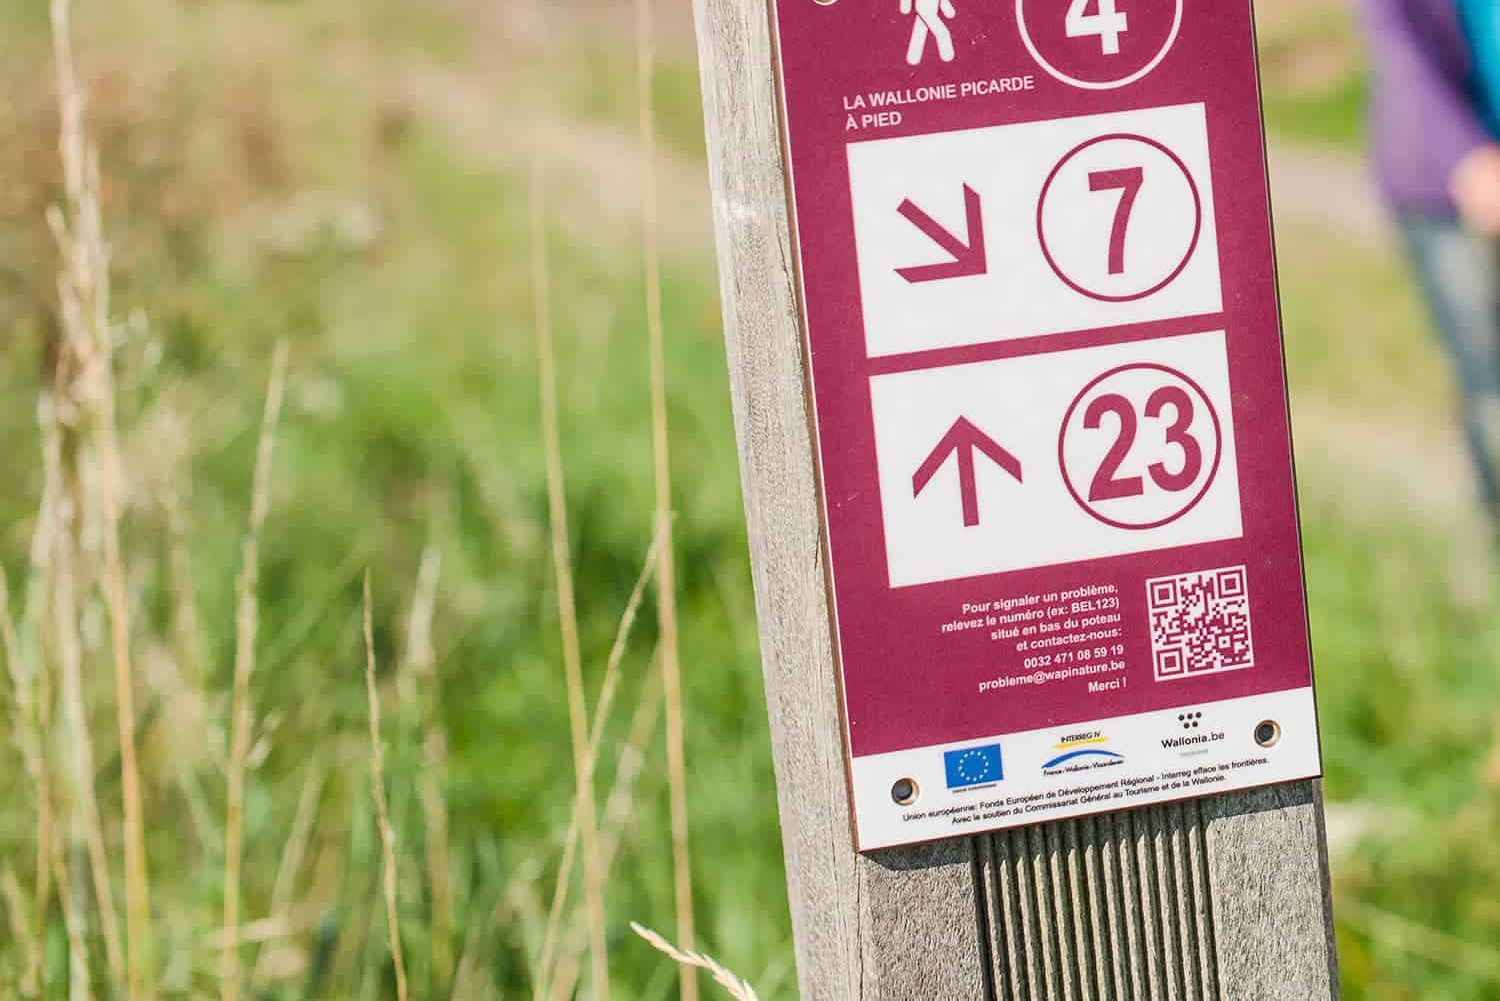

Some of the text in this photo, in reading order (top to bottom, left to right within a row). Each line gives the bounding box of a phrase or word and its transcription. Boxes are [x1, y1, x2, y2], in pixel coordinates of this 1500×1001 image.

[843, 75, 1035, 110] LA WALLONIE PICARDE
[845, 111, 902, 131] À PIED
[1088, 166, 1144, 275] 7
[1083, 385, 1202, 502] 23
[942, 597, 1120, 633] relevez le numéro (ex: BEL123)
[962, 602, 991, 614] Pour
[994, 596, 1040, 612] signaler
[1045, 593, 1058, 603] un
[991, 613, 1121, 640] situé en bas du poteau
[1016, 628, 1122, 652] et contactez-nous:
[1024, 644, 1124, 669] 0032 471 08 59 19
[978, 660, 1125, 693] probleme@wapinature.be
[1088, 679, 1120, 693] Merci
[1161, 732, 1225, 749] Wallonia.be
[902, 812, 926, 822] Union
[979, 799, 1005, 810] Fonds
[1006, 793, 1044, 808] Européen
[1046, 790, 1056, 799] de
[1121, 775, 1154, 789] Régional
[1162, 769, 1191, 782] Interreg
[1218, 762, 1230, 772] les
[952, 815, 972, 825] Avec
[974, 812, 981, 820] le
[983, 808, 1011, 820] soutien
[1013, 806, 1023, 815] du
[1025, 798, 1078, 813] Commissariat
[1080, 790, 1111, 803] Général
[1125, 785, 1160, 797] Tourisme
[1162, 782, 1169, 790] et
[1171, 780, 1181, 789] de
[1183, 778, 1190, 787] la
